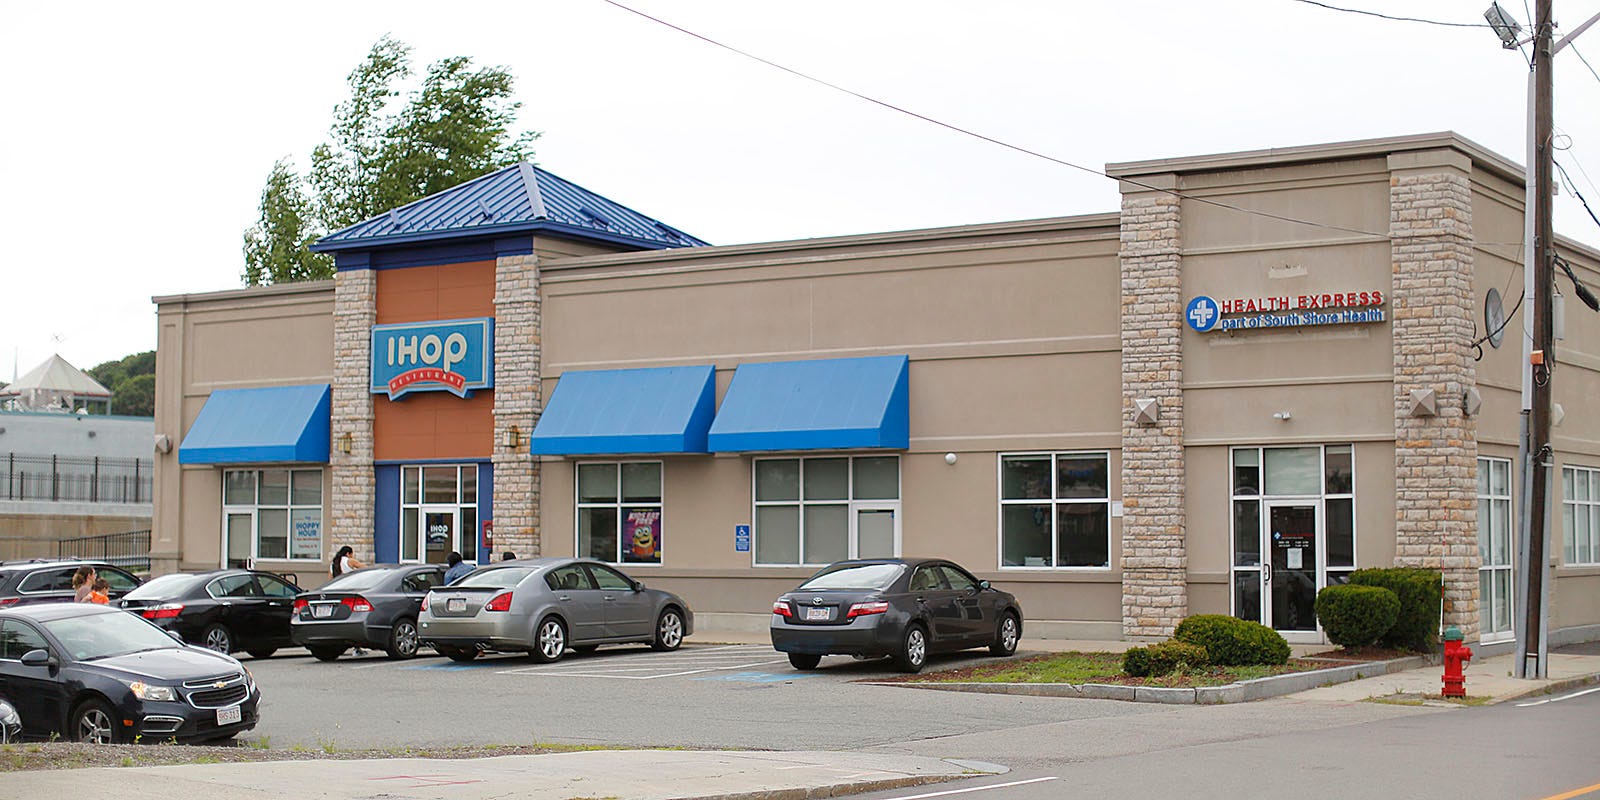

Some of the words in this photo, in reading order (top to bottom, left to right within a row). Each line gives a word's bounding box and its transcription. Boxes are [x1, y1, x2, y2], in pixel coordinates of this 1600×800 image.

[1221, 296, 1290, 313] HEALTH
[1298, 290, 1383, 309] EXPRESS
[1221, 316, 1247, 331] part
[1249, 314, 1264, 328] of
[1264, 312, 1300, 327] South
[1302, 311, 1339, 325] Shore
[1342, 308, 1383, 322] Health
[391, 370, 462, 390] RESTAURANT
